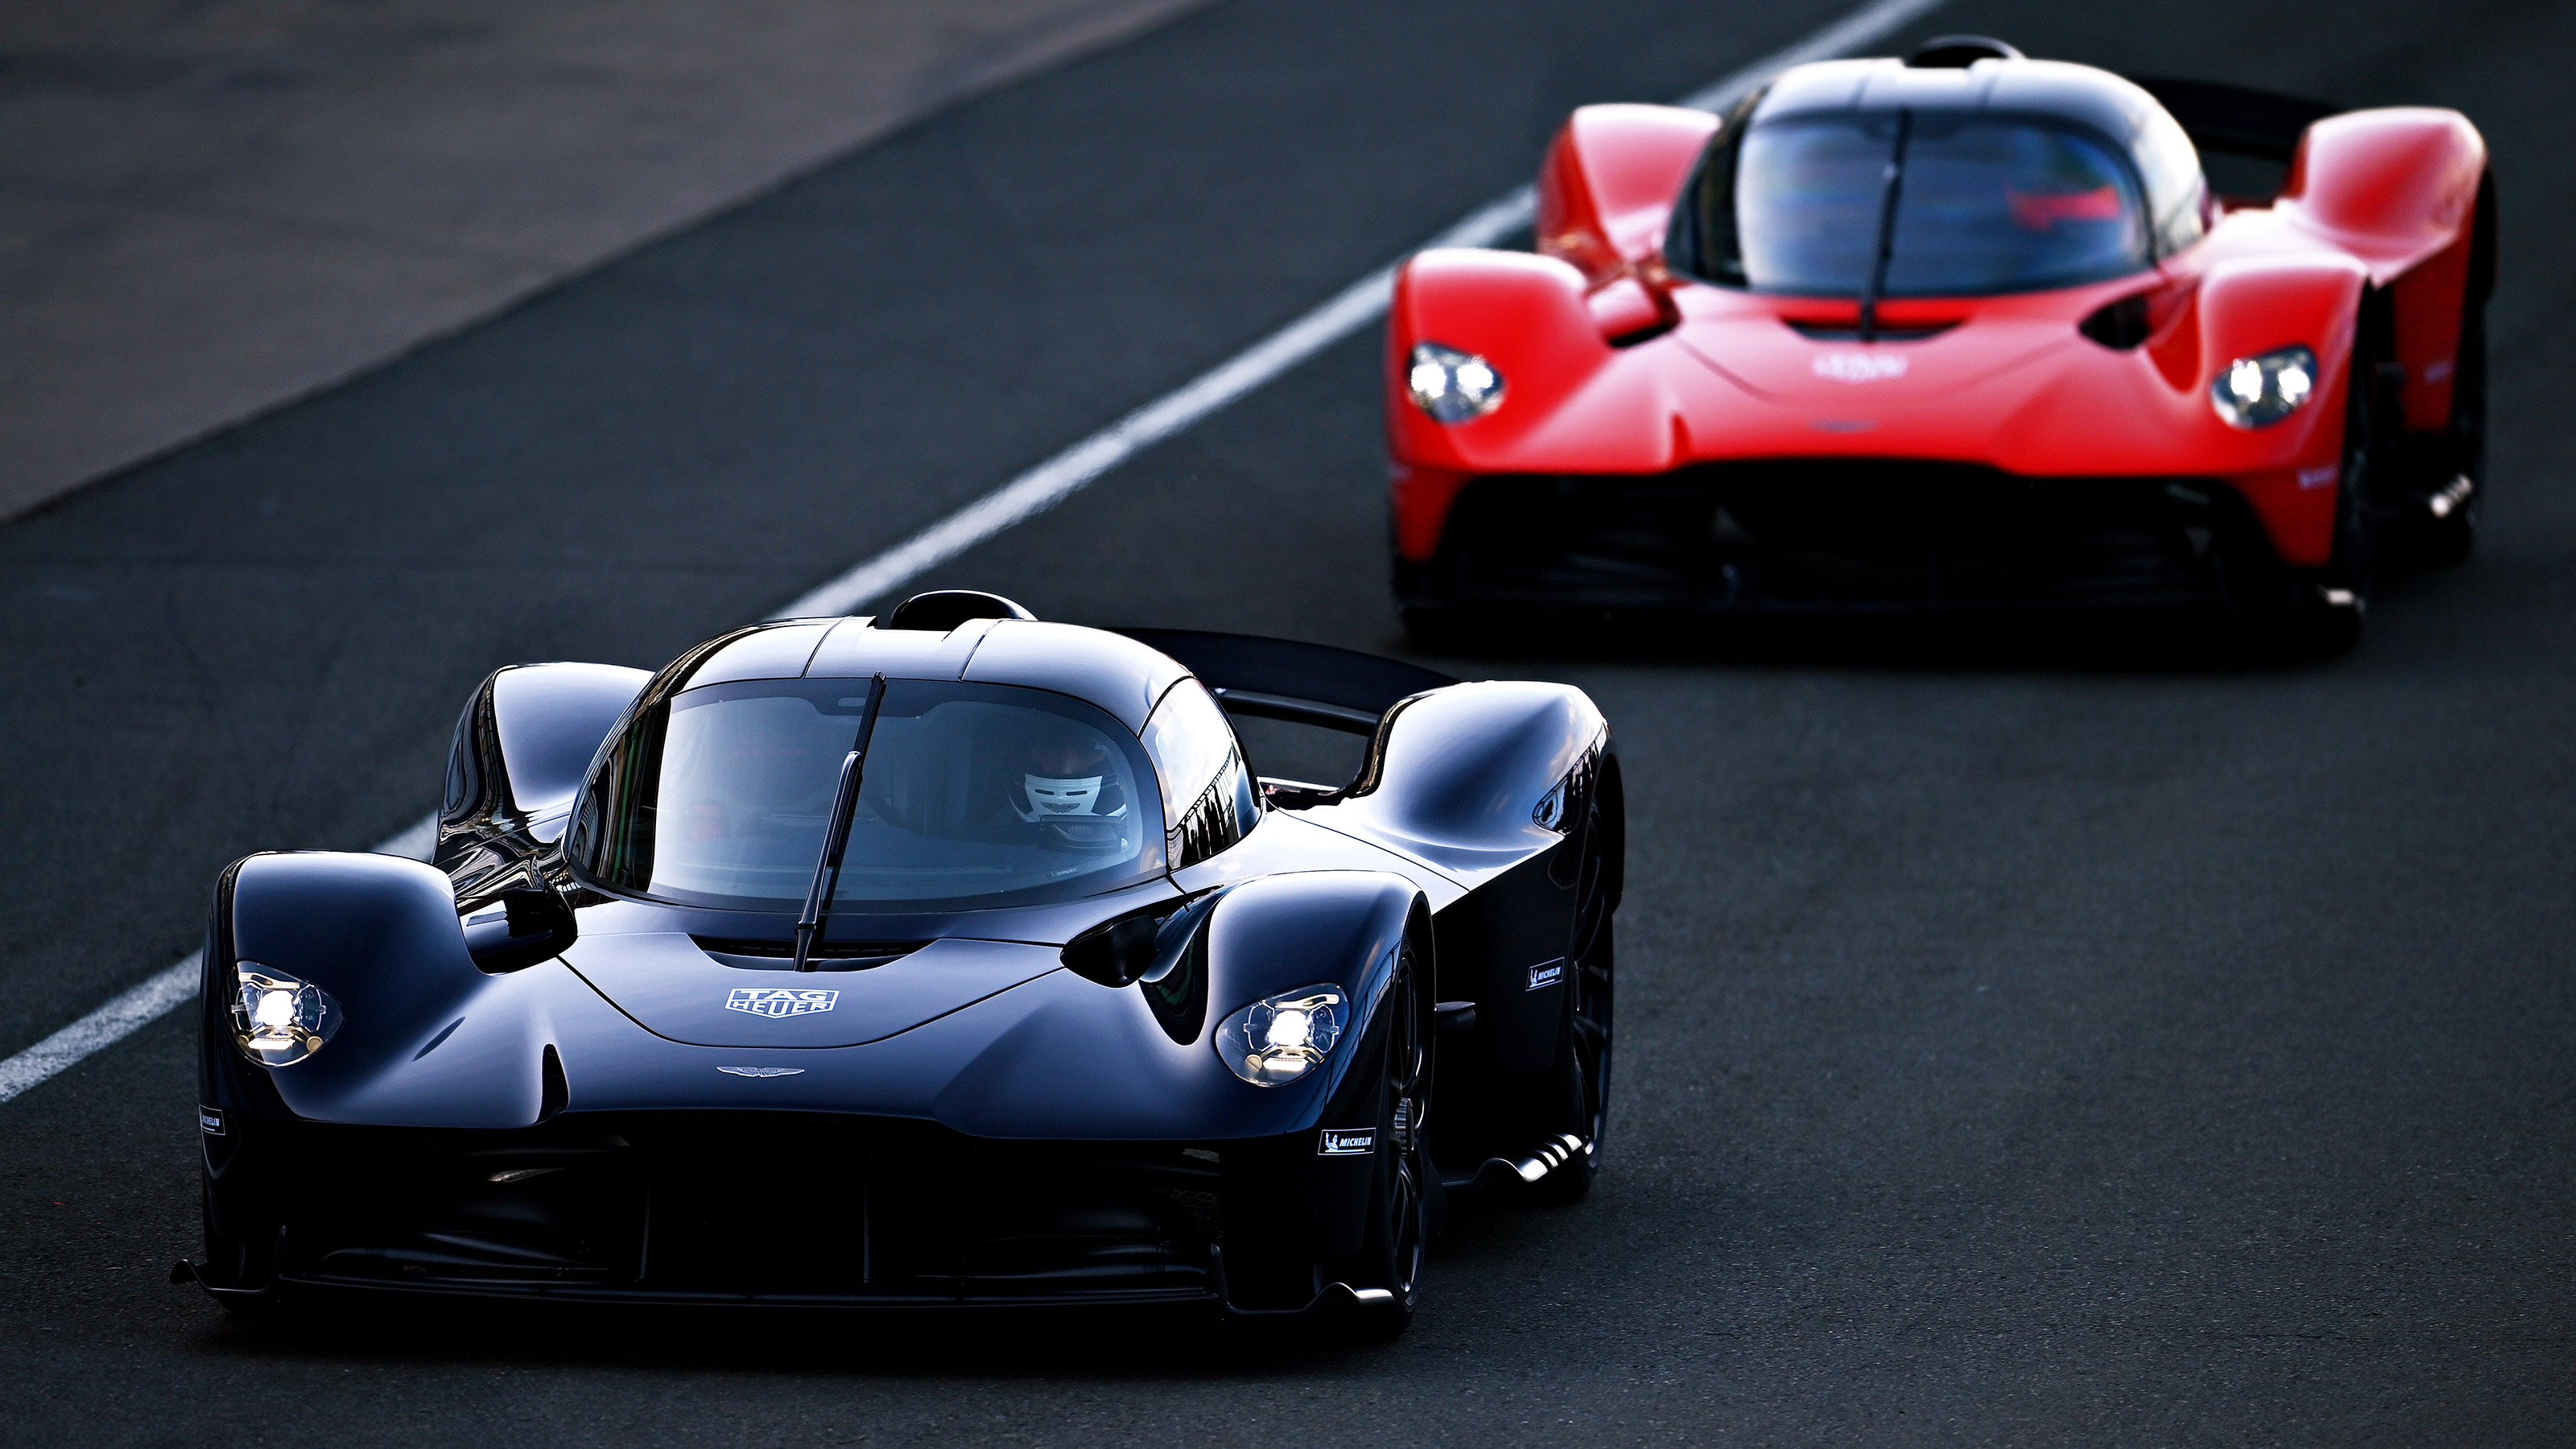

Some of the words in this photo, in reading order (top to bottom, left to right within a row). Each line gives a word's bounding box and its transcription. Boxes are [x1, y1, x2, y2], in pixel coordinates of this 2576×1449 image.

[741, 990, 828, 1001] TAG
[732, 1001, 828, 1016] HEUER
[1340, 1137, 1372, 1147] MICHELIN
